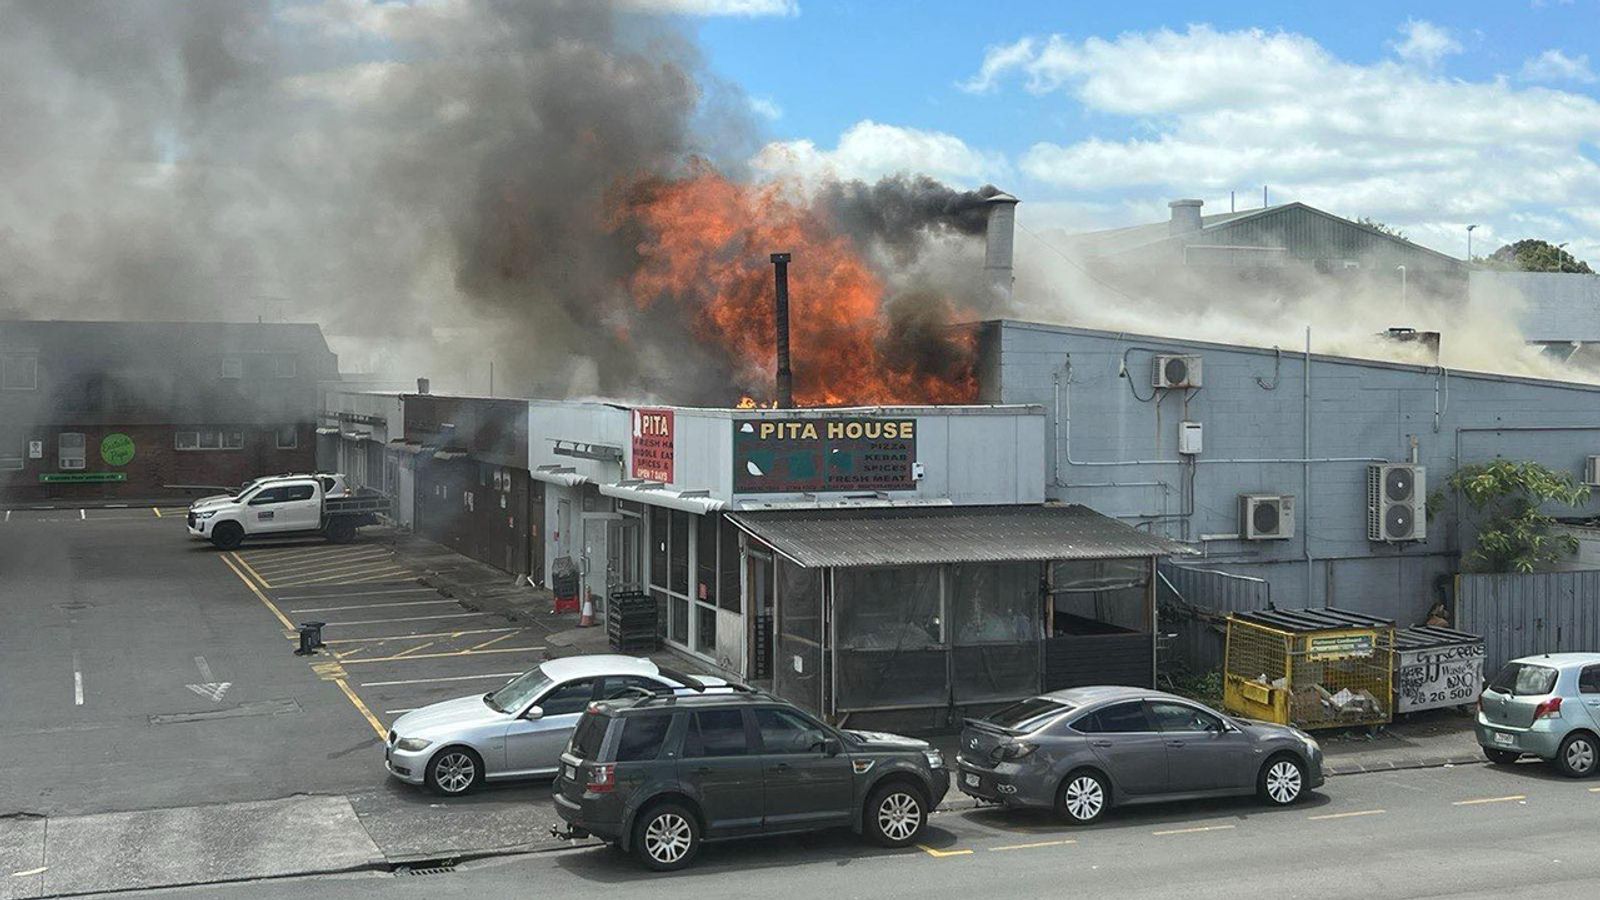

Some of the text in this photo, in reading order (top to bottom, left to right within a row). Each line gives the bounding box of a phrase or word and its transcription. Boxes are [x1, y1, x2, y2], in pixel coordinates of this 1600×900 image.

[642, 415, 669, 436] PITA
[760, 422, 913, 440] PITA HOUSE
[864, 454, 907, 462] KEBAB
[863, 463, 907, 472] SPICES
[1430, 691, 1446, 702] 26
[1450, 688, 1473, 700] 500
